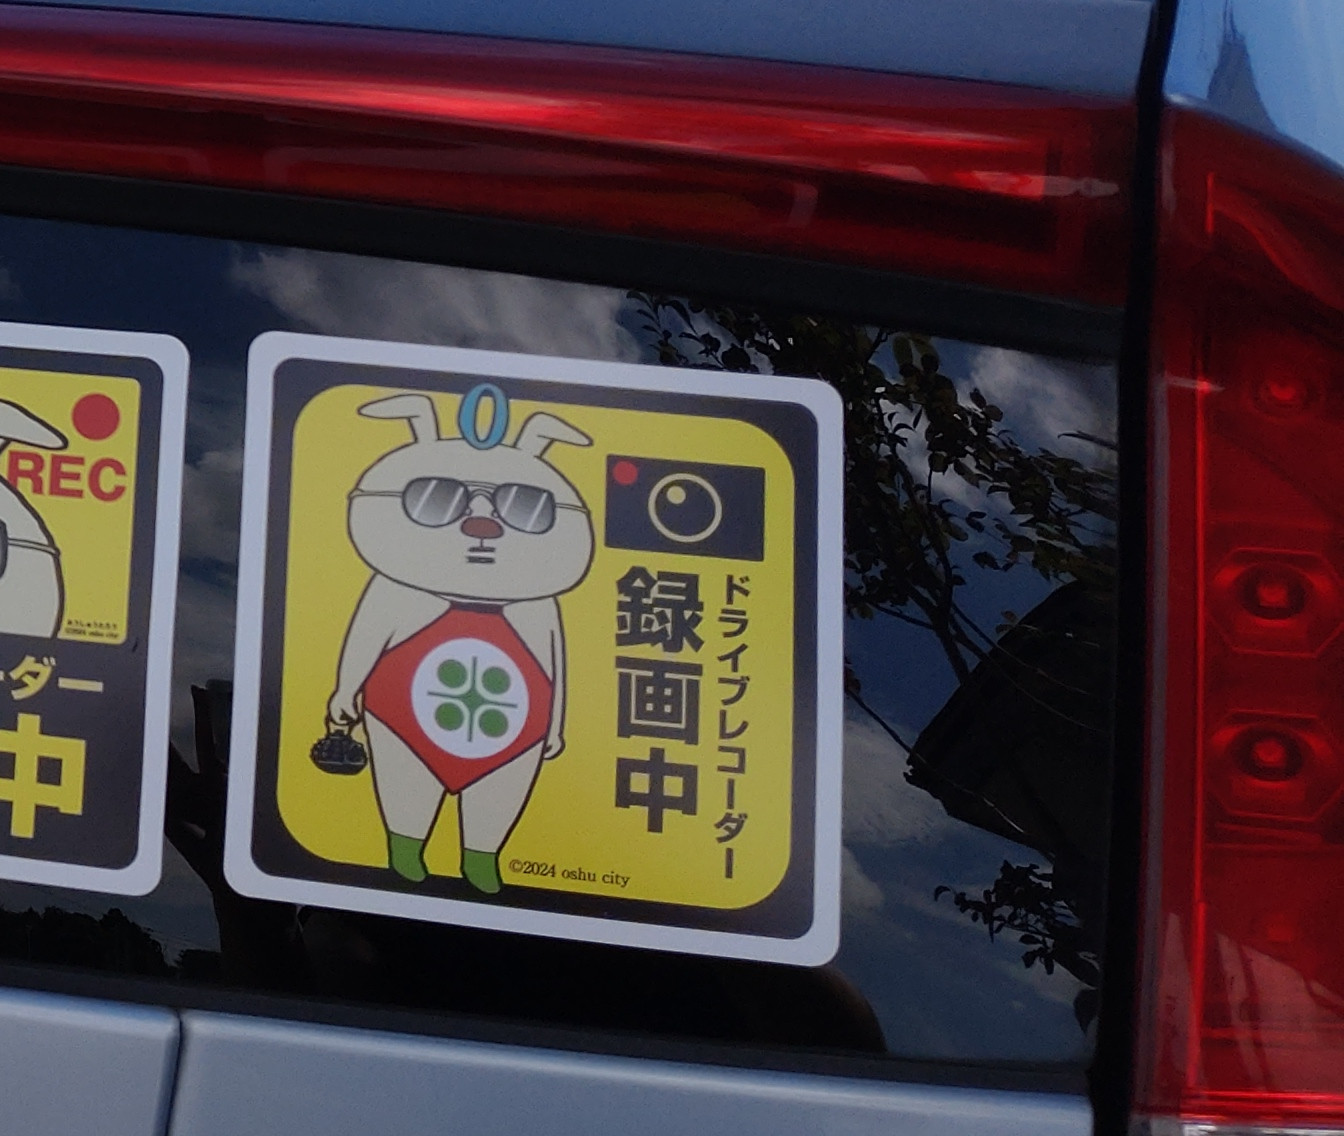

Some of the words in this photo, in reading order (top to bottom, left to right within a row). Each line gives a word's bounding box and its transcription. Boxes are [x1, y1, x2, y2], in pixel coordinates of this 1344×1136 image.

[7, 449, 127, 502] REC
[614, 564, 705, 834] 録画中
[714, 572, 751, 879] ドライブレコーダー
[508, 858, 557, 878] ©2024
[560, 866, 597, 883] oshu
[601, 870, 632, 889] city
